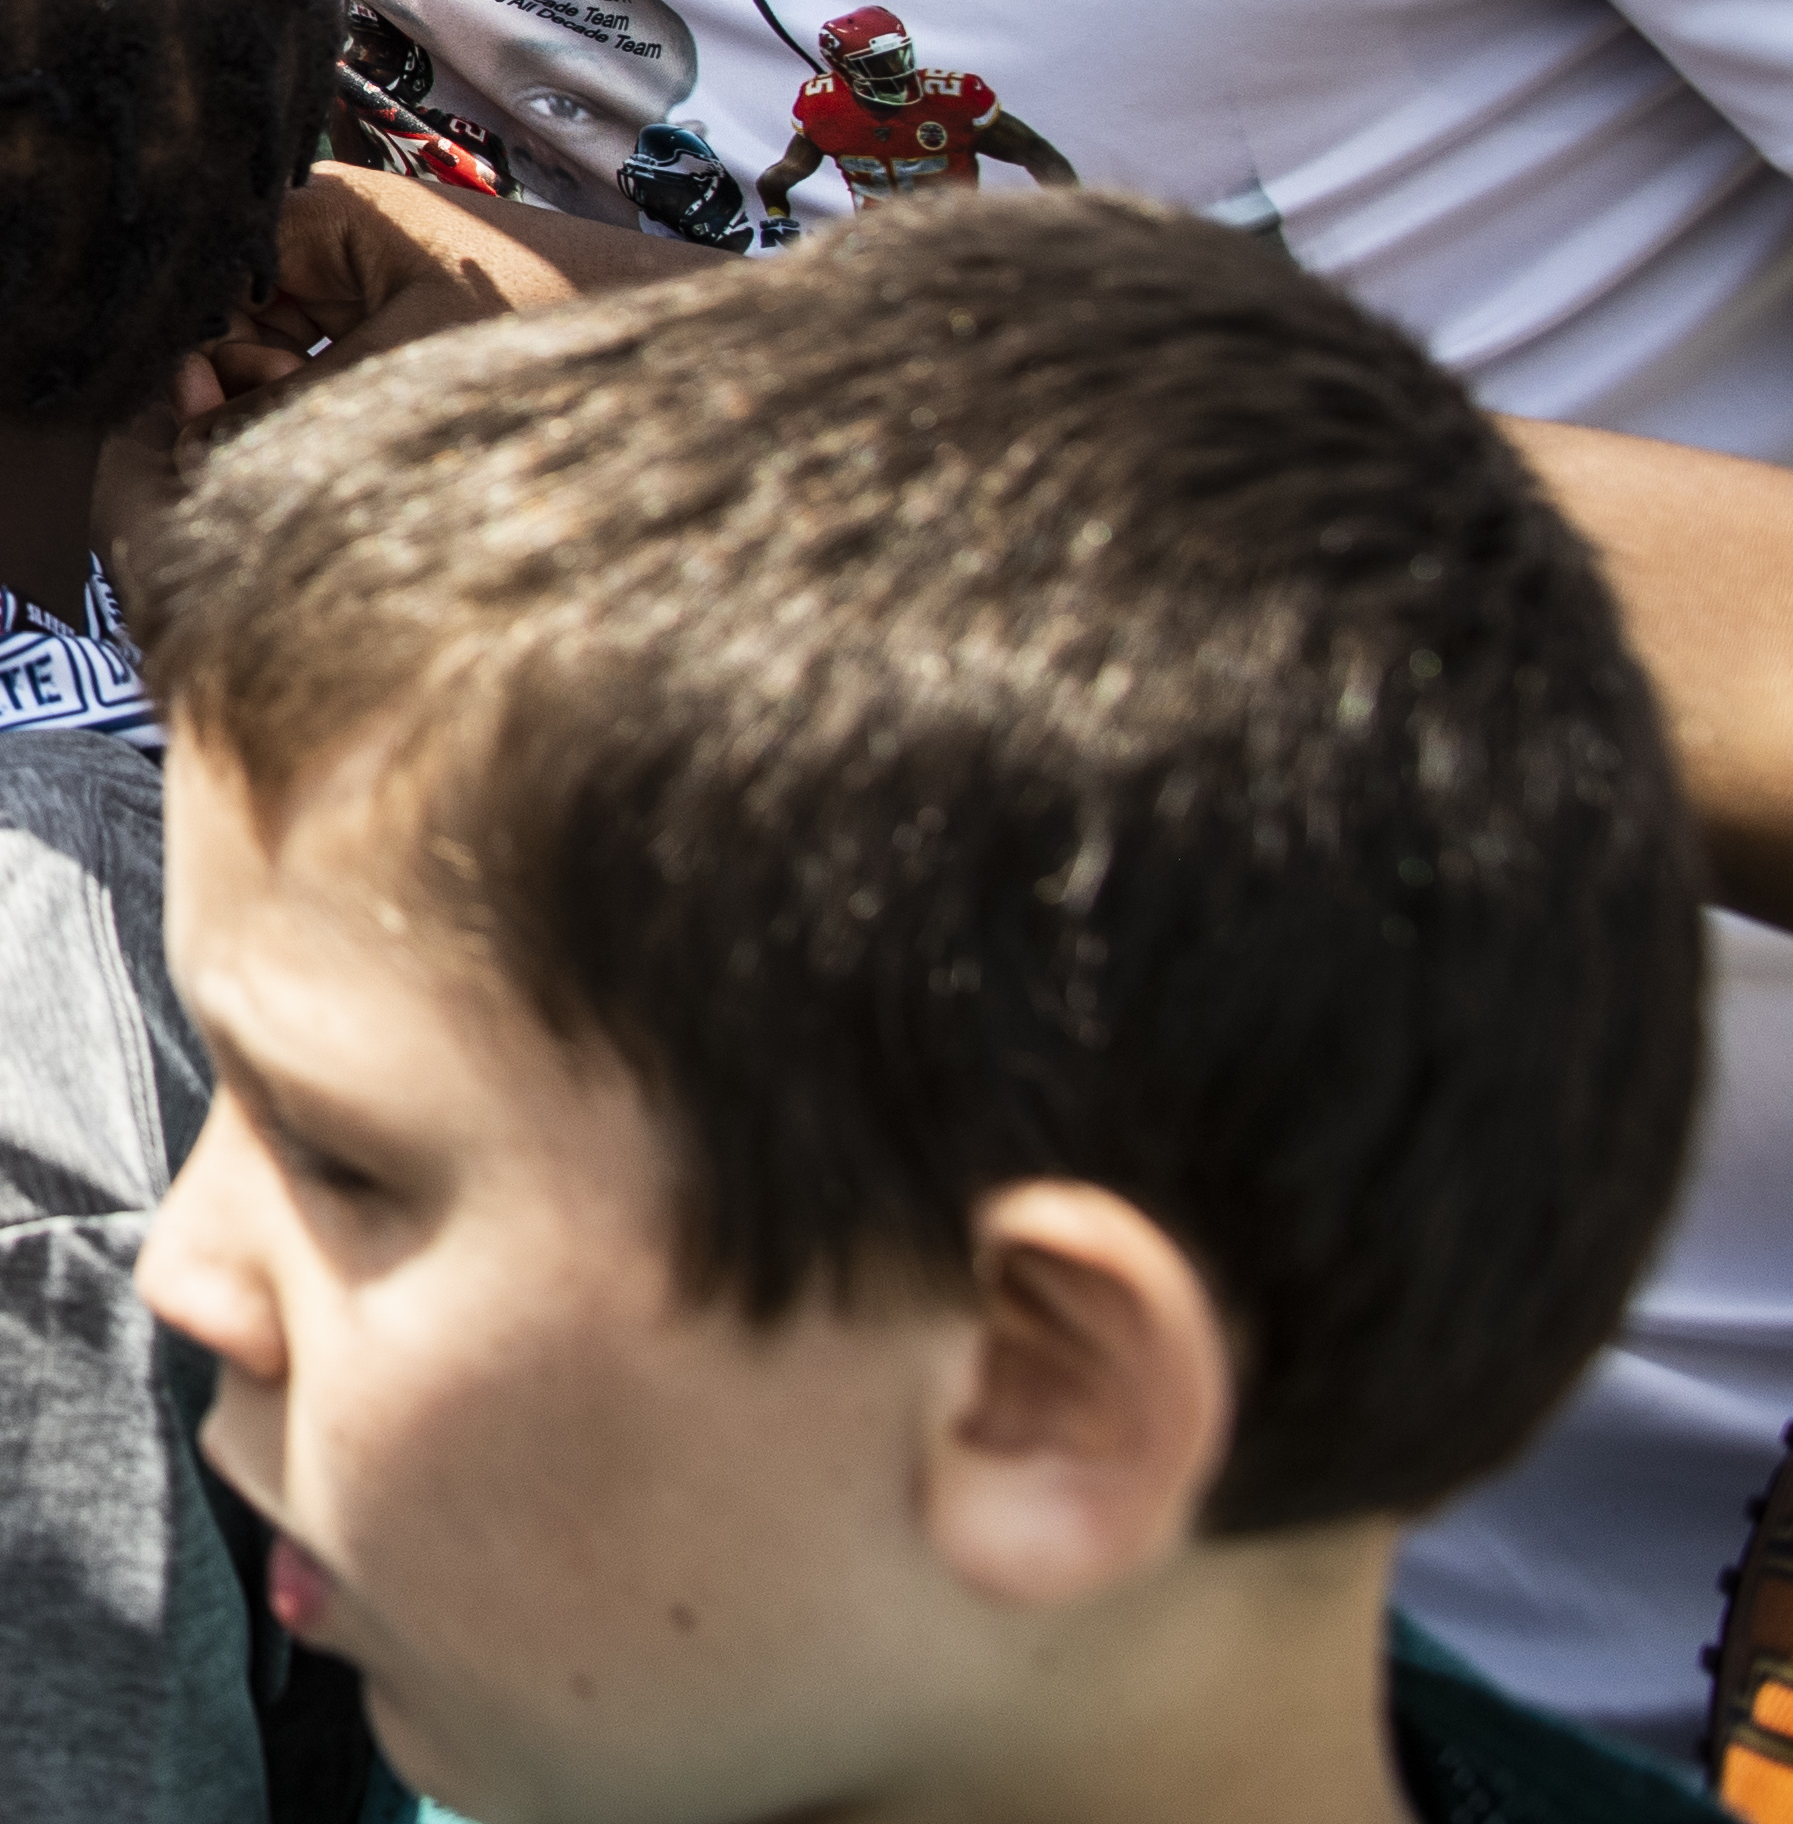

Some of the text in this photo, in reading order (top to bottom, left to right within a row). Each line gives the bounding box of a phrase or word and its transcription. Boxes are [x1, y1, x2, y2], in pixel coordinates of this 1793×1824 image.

[535, 7, 609, 43] Decade
[614, 34, 662, 59] Team
[583, 6, 630, 31] Team
